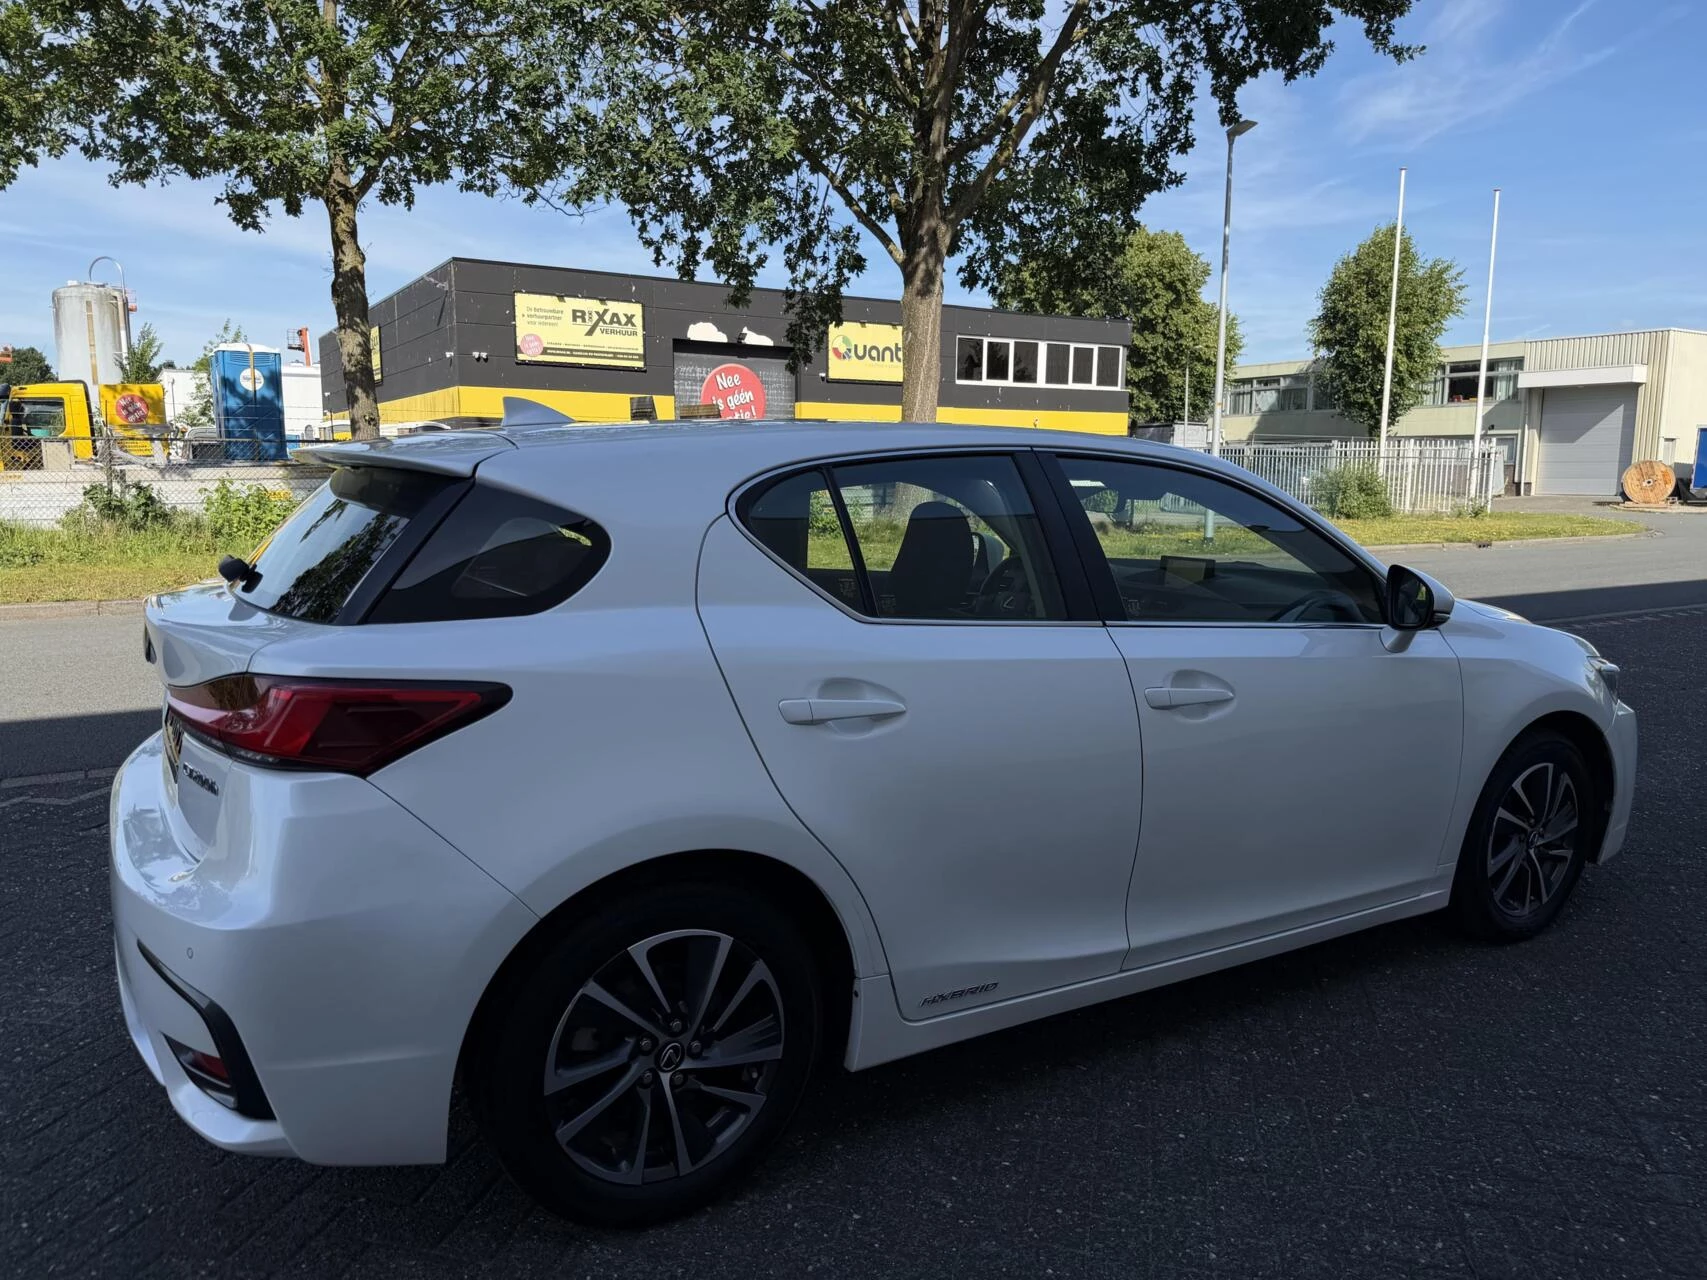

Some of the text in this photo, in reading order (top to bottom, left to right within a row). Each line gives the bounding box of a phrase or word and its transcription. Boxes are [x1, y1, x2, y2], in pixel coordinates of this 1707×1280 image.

[599, 328, 638, 337] VERHUUR
[715, 372, 741, 391] Nee
[727, 388, 754, 410] géén
[920, 982, 999, 1007] HYBRID
